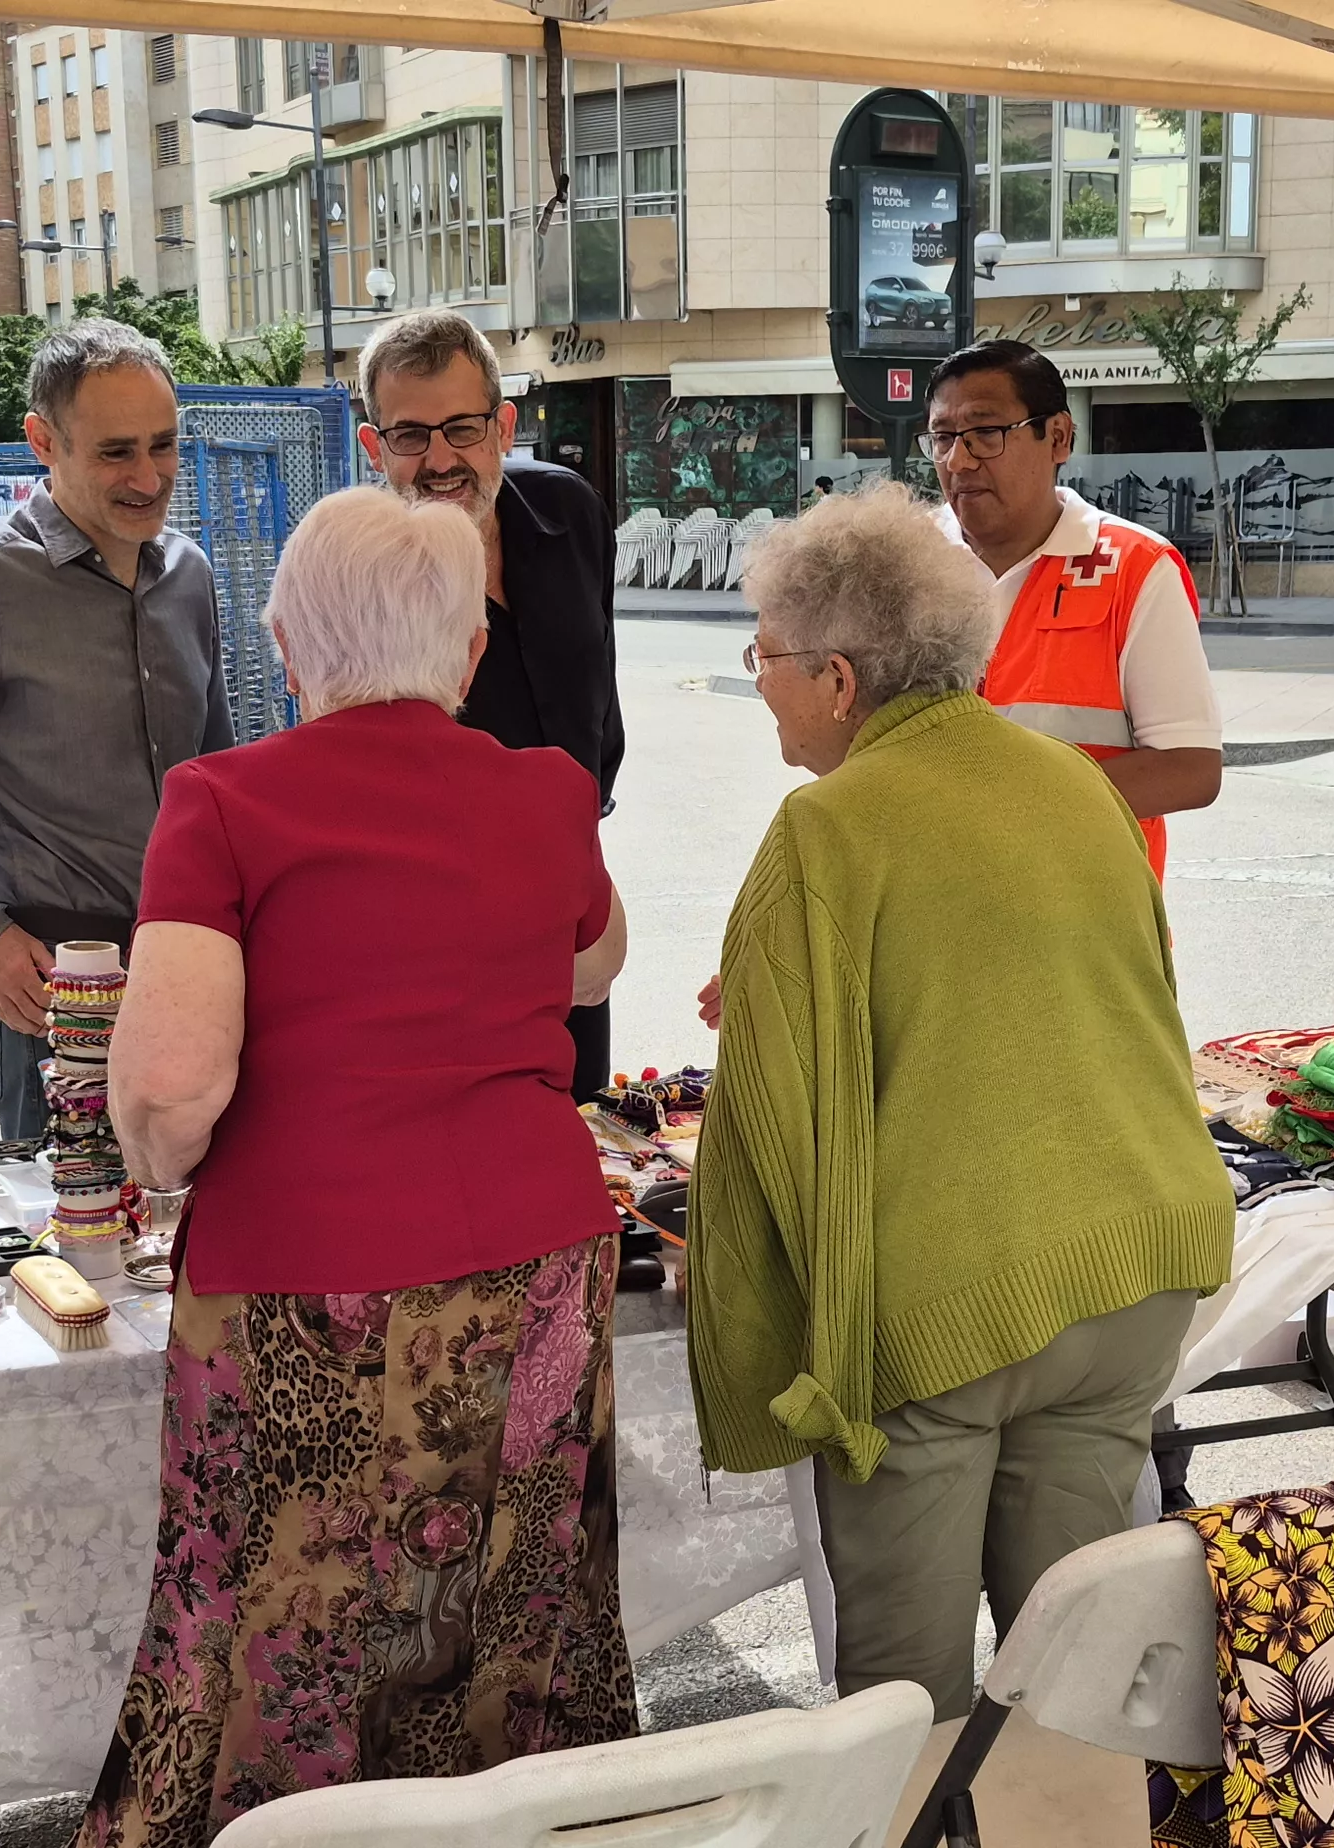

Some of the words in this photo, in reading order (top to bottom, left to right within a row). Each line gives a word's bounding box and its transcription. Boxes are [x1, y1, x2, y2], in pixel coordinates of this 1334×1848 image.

[873, 186, 889, 196] POR
[873, 197, 883, 206] TU
[883, 197, 910, 207] COCHE
[550, 322, 604, 366] Bar
[1060, 368, 1099, 381] ANJA
[1105, 366, 1151, 379] ANITA
